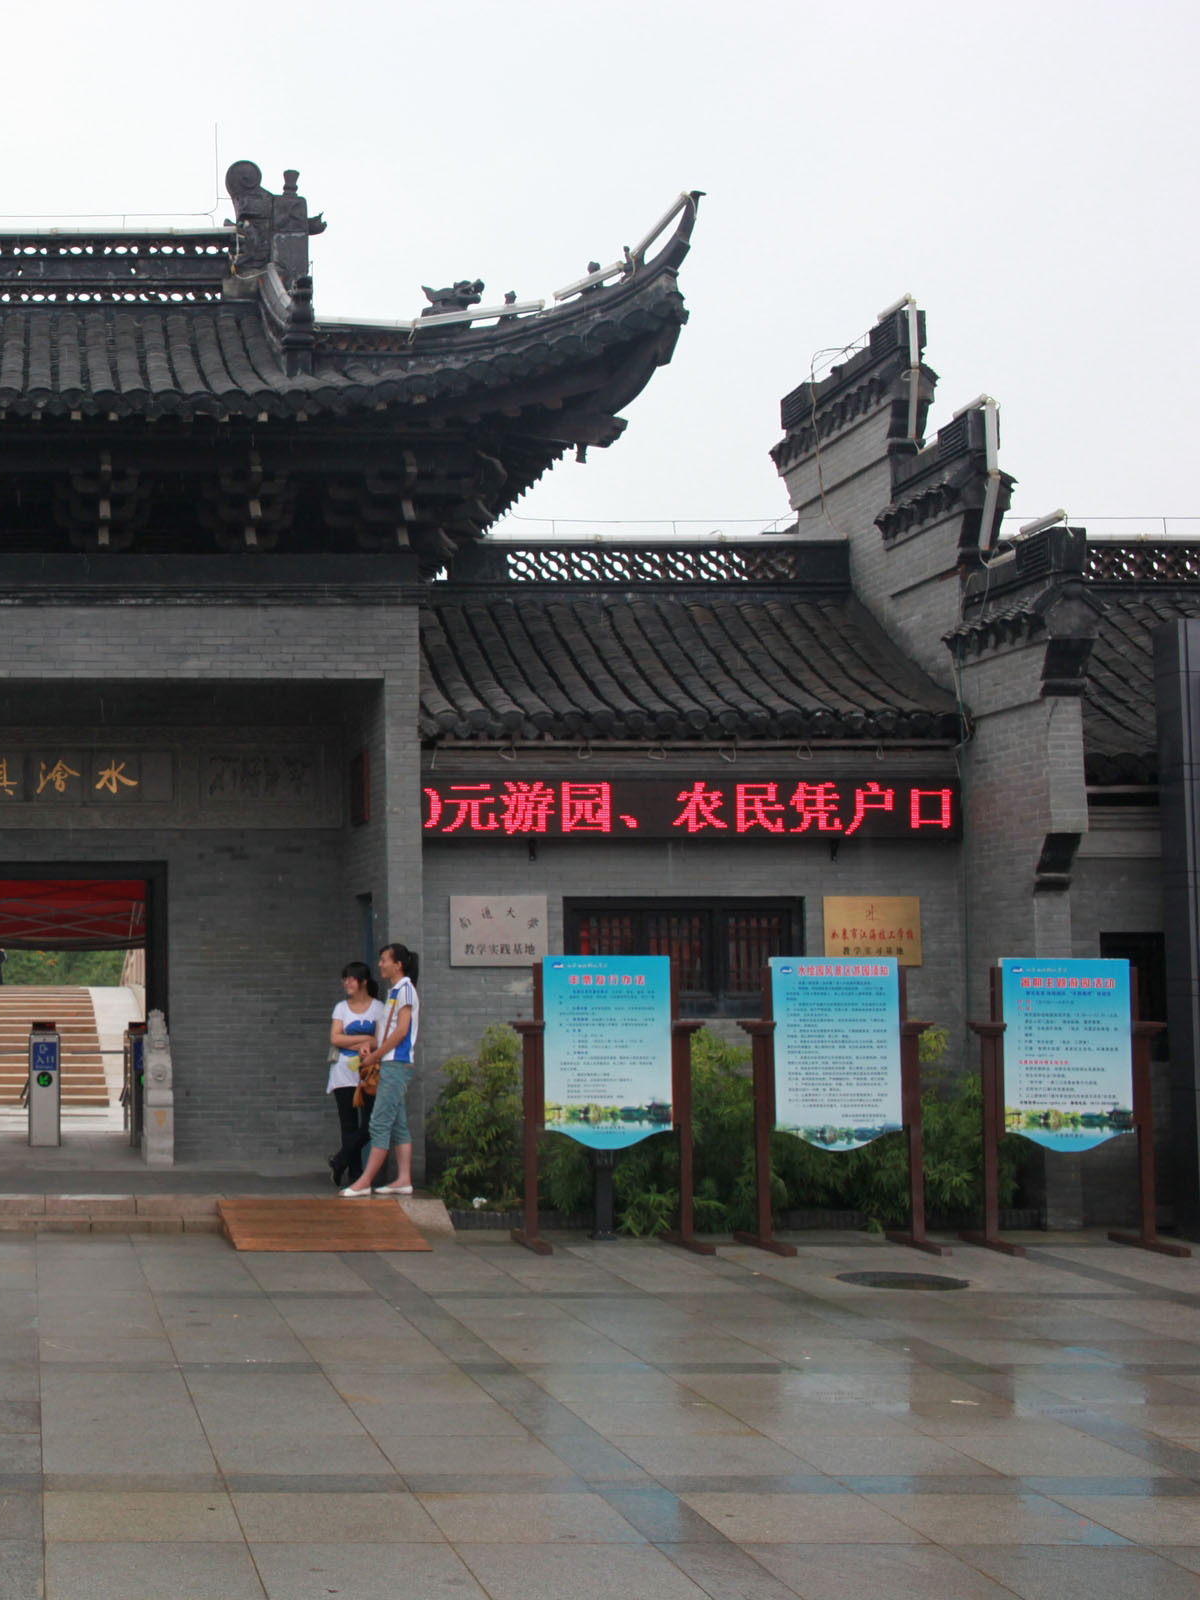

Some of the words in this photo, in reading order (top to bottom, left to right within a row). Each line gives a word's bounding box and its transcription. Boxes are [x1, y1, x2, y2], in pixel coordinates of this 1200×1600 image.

[464, 943, 536, 956] 教学实践基地
